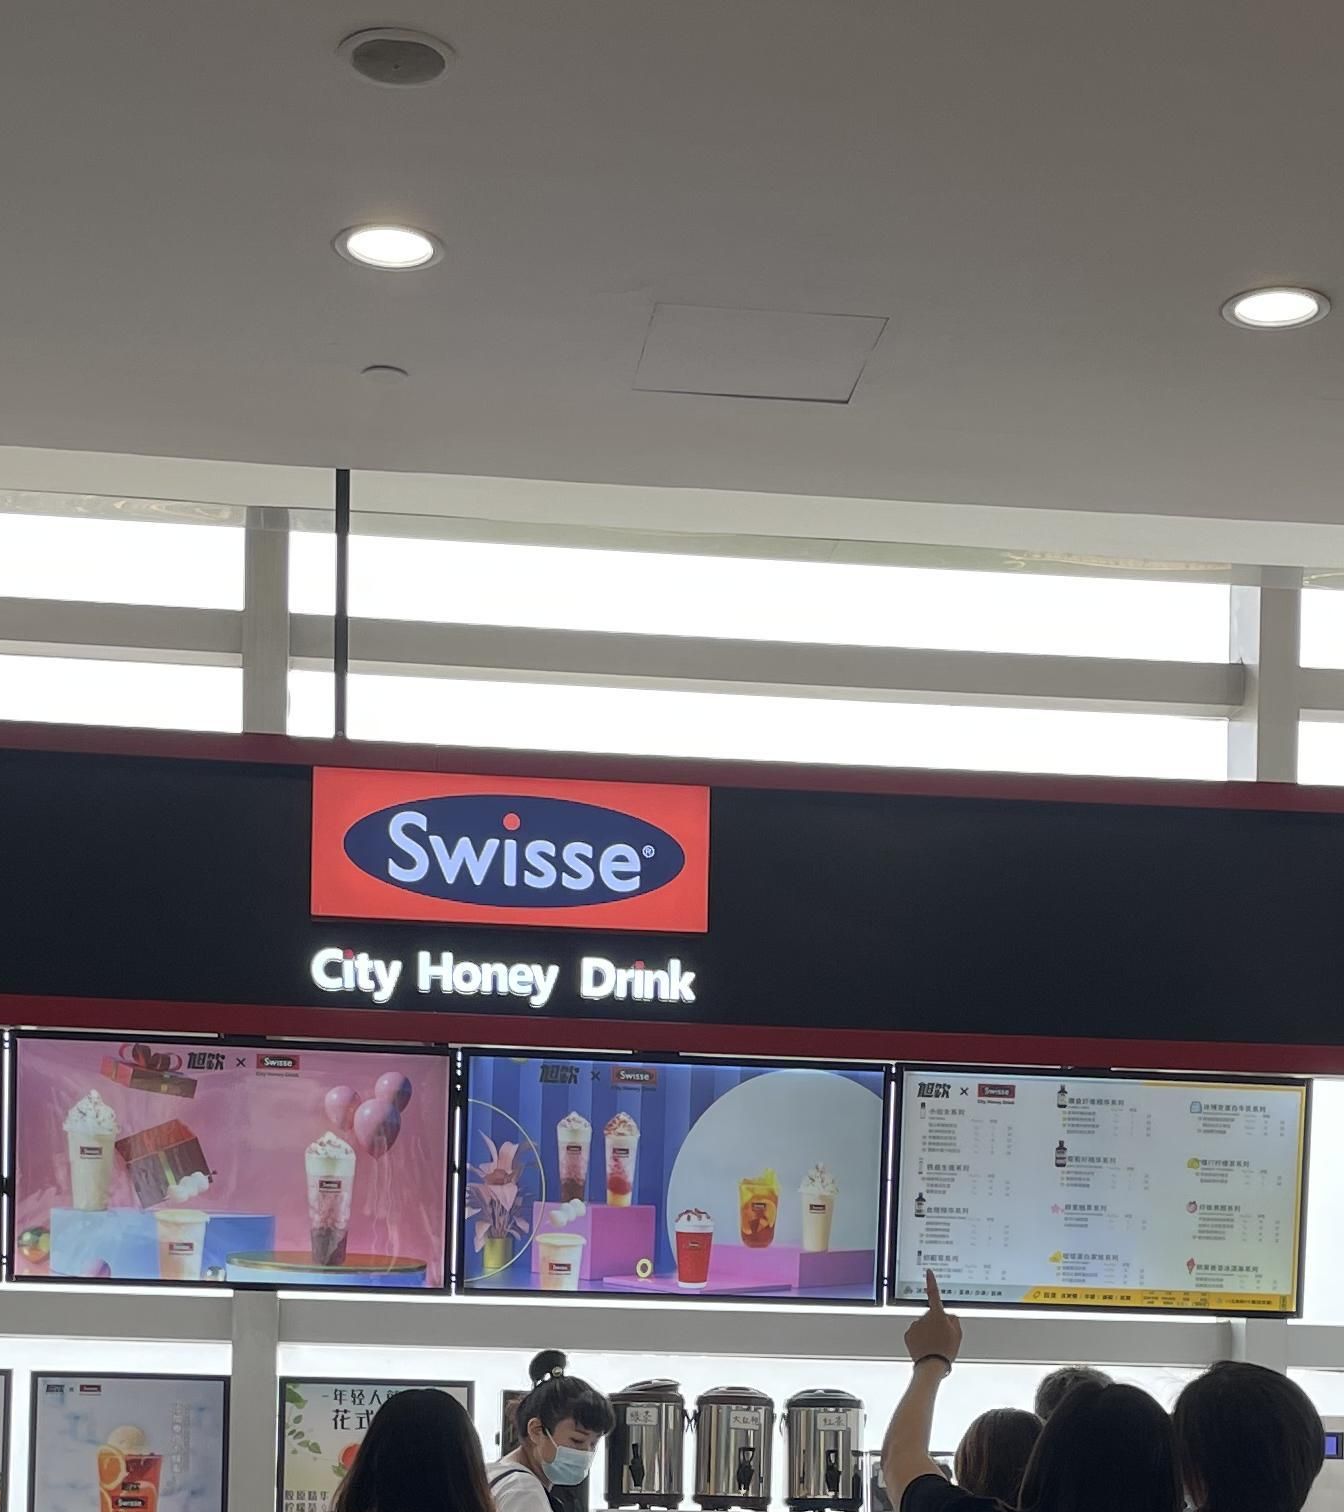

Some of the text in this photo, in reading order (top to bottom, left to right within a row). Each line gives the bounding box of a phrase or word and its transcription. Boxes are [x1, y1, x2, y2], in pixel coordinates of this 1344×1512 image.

[388, 811, 642, 893] Swisse
[310, 947, 696, 1009] City Honey Drink
[917, 1082, 951, 1099] 旭饮
